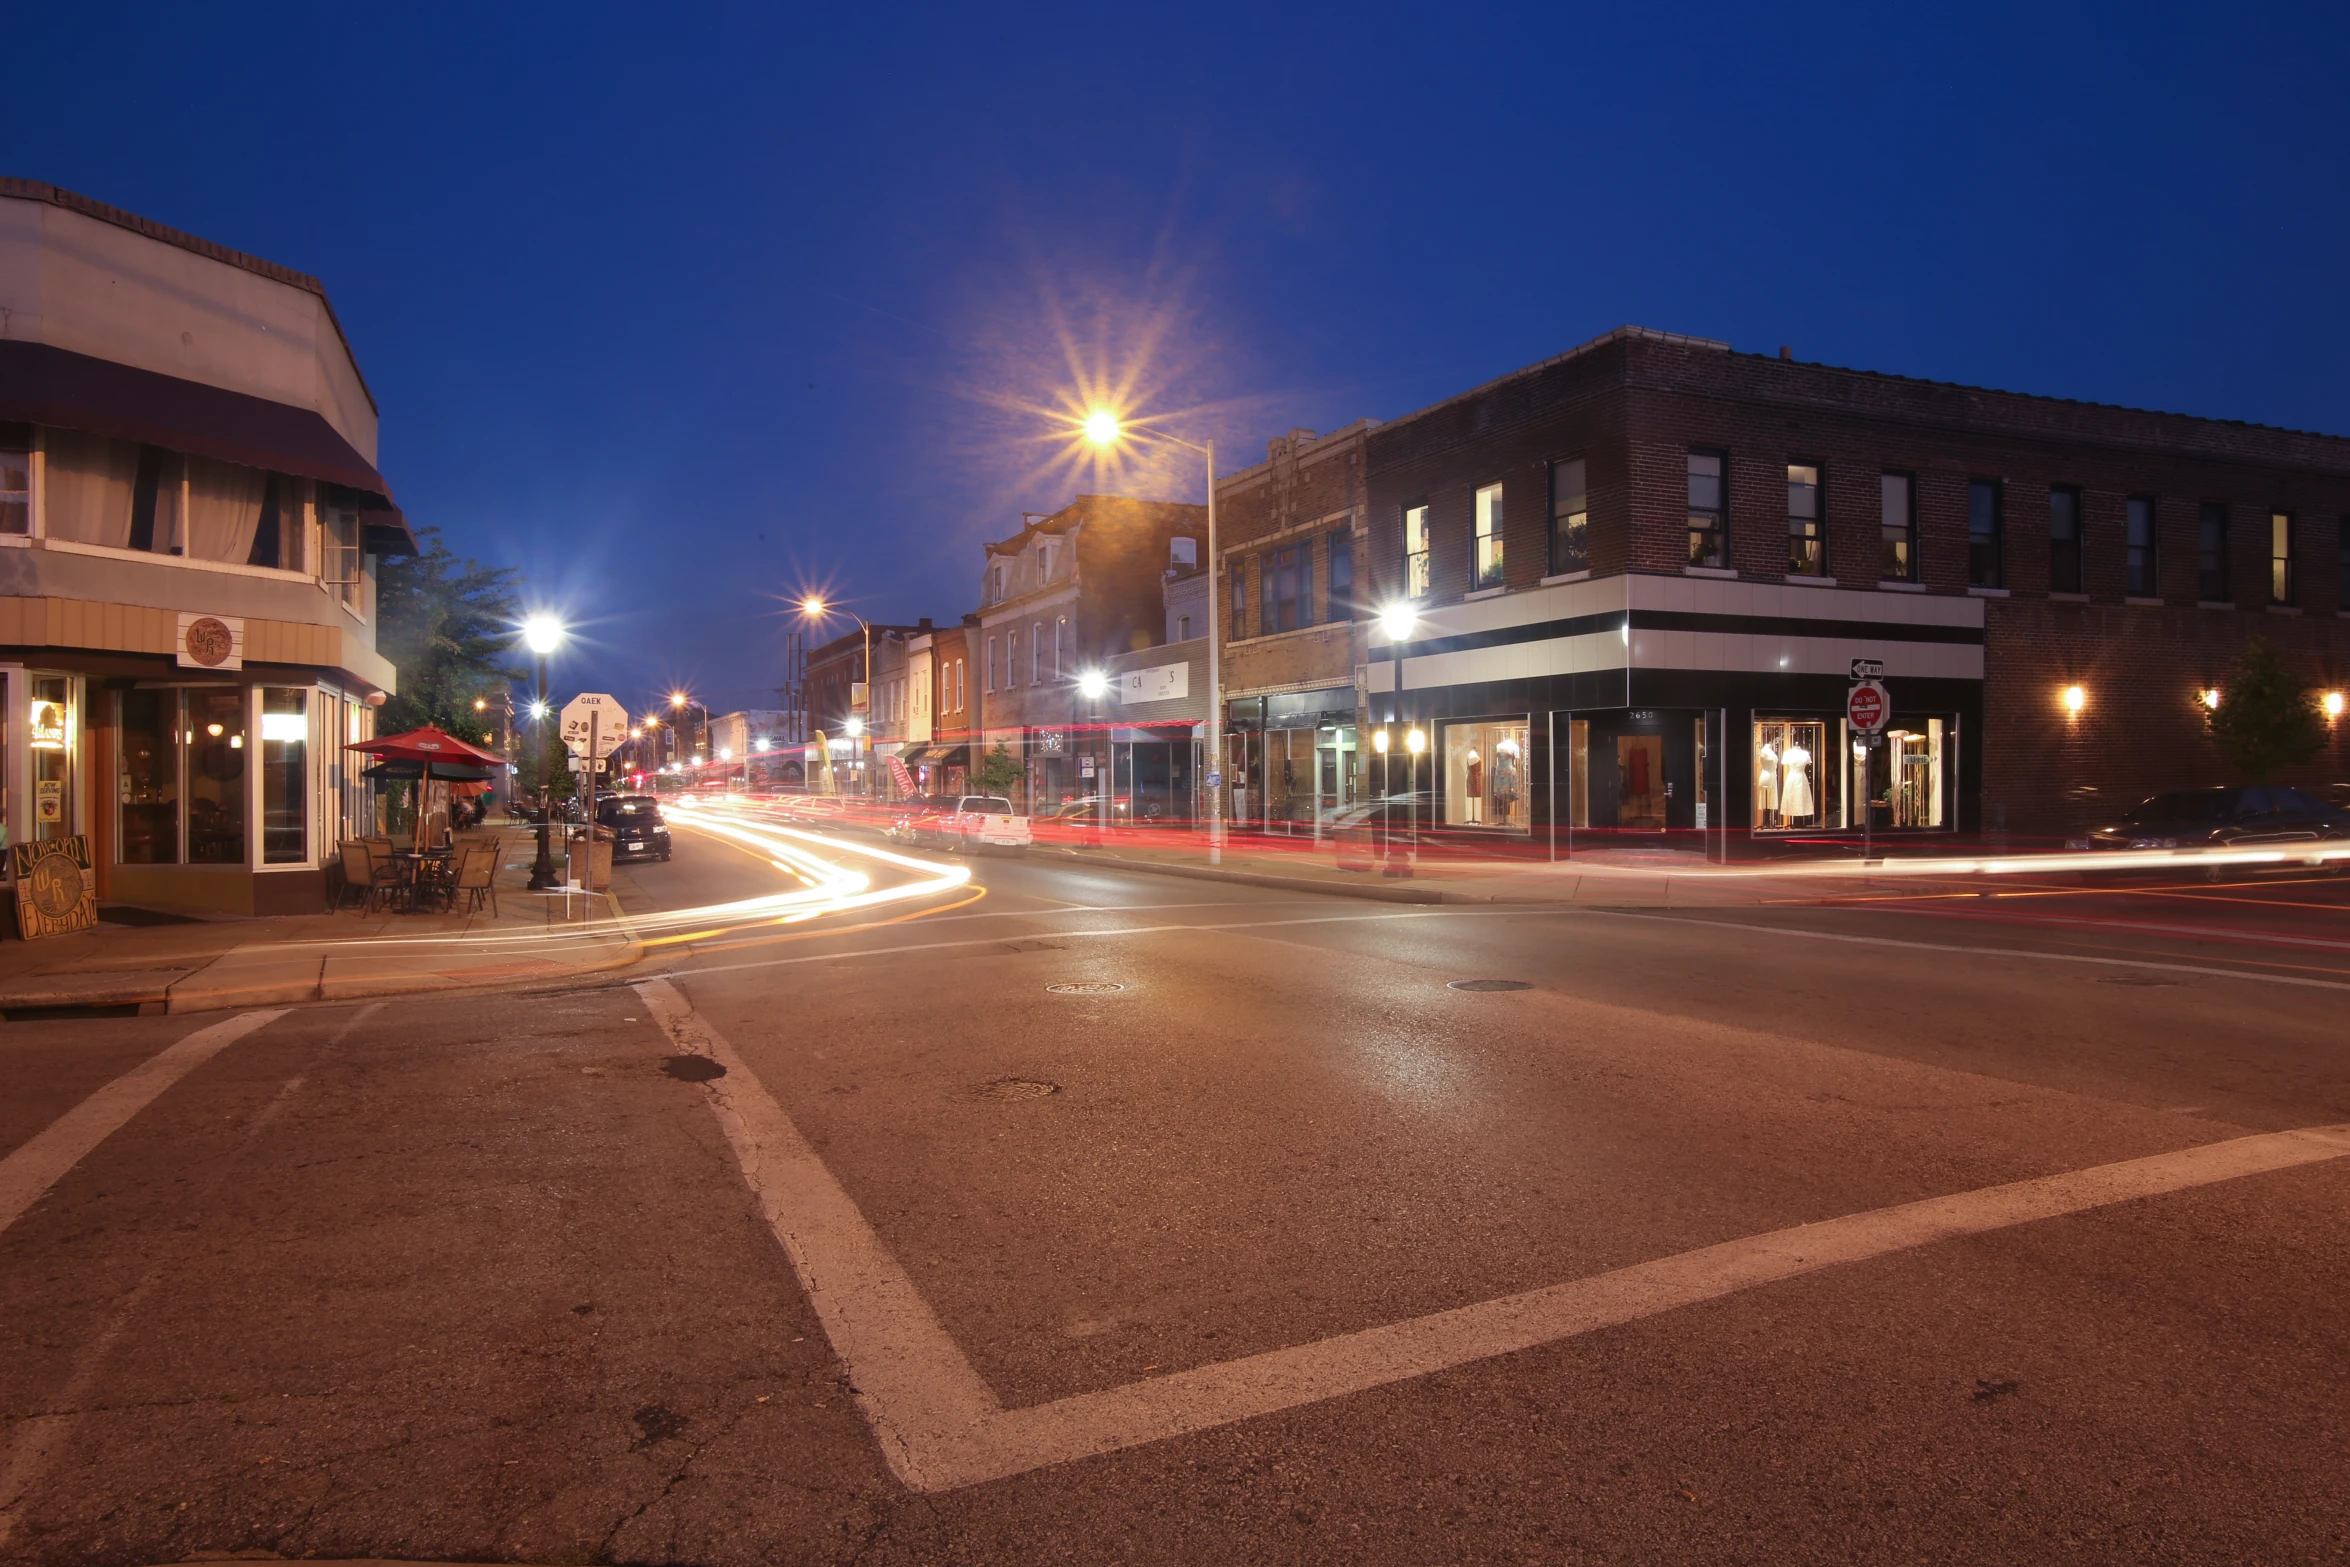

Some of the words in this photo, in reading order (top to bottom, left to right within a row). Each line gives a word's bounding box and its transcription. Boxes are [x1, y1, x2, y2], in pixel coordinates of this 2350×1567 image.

[1857, 664, 1869, 674] ONE
[1870, 665, 1881, 675] WAY
[1629, 711, 1653, 719] 2650
[1857, 712, 1875, 720] ENTER
[15, 840, 51, 876] NOW
[56, 835, 89, 866] OPEN
